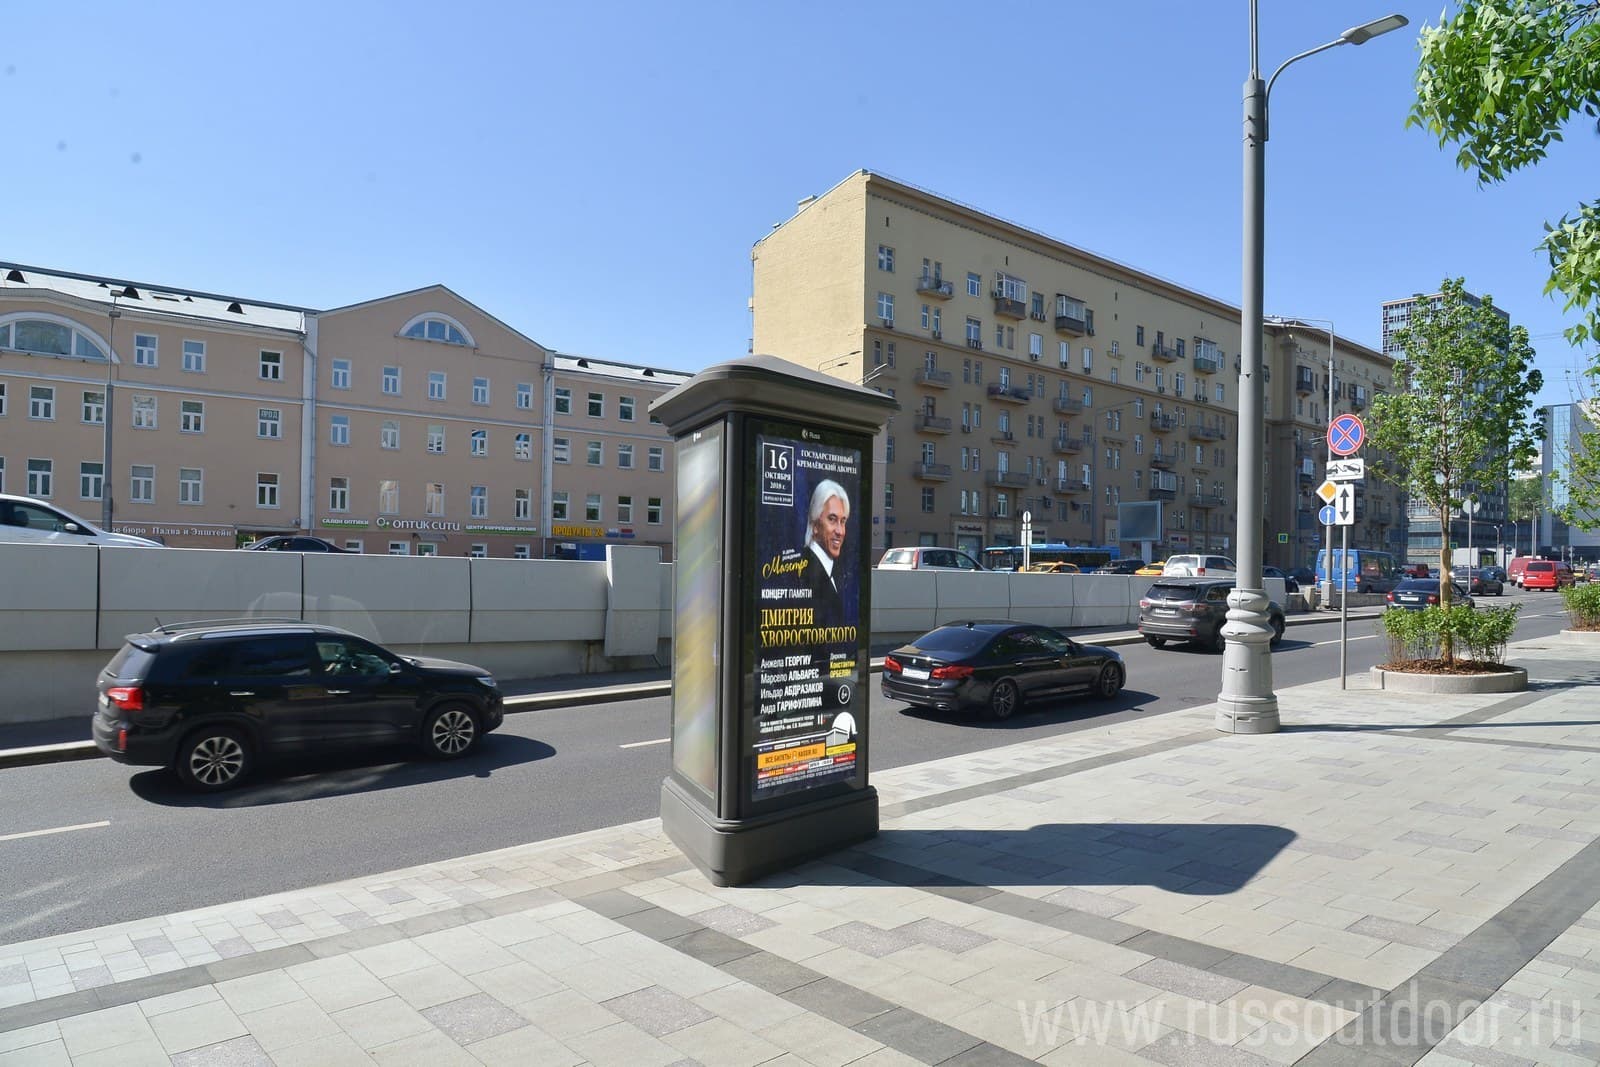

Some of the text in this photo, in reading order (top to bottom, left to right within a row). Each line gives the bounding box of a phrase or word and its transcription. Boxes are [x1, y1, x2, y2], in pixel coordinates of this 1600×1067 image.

[769, 449, 788, 471] 16
[801, 449, 853, 463] ГОСУДАРСТВЕННЫЙ
[765, 471, 791, 481] ОКТЯБРЯ
[837, 464, 857, 475] ДВОРЕЦ
[552, 525, 593, 537] ПРОДУКТЫ
[761, 588, 812, 600] КОНЦЕРТ ПАМЯТИ
[761, 608, 814, 628] ДМИТРИЯ
[761, 626, 857, 648] ХВОРОСТОВСКОГО
[760, 655, 812, 669] Анжела ГЕОРГИУ
[760, 669, 820, 685] Марсело АЛЬВАРЕС
[760, 682, 824, 700] Ильдар АБДРАЗАКОВ
[776, 696, 823, 712] ГАРИФУЛЛИНА
